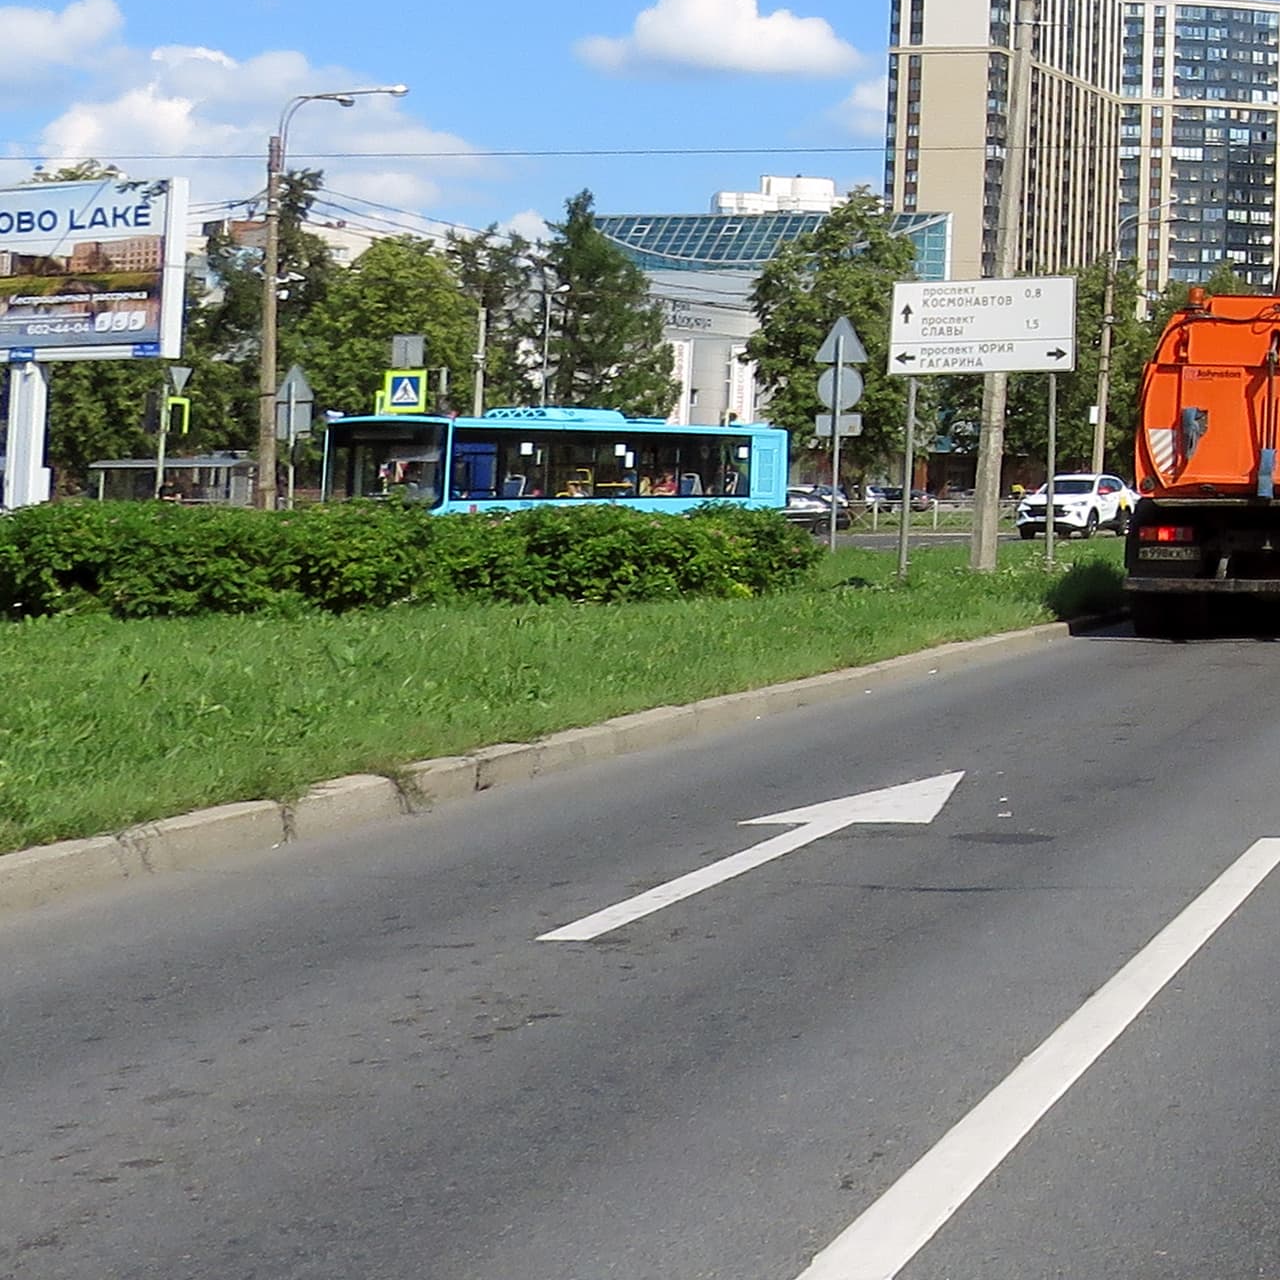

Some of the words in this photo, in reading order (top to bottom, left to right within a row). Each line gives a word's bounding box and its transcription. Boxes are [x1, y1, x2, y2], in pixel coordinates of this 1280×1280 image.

[69, 205, 152, 231] LAKE
[922, 287, 976, 297] проспект
[922, 296, 1013, 308] КОСМОНАВТОВ
[921, 316, 975, 326] проспект
[921, 326, 964, 337] СЛАВЫ
[920, 346, 973, 356] проспект
[978, 343, 1014, 353] ЮРИЯ
[920, 357, 984, 369] ГАГАРИНА
